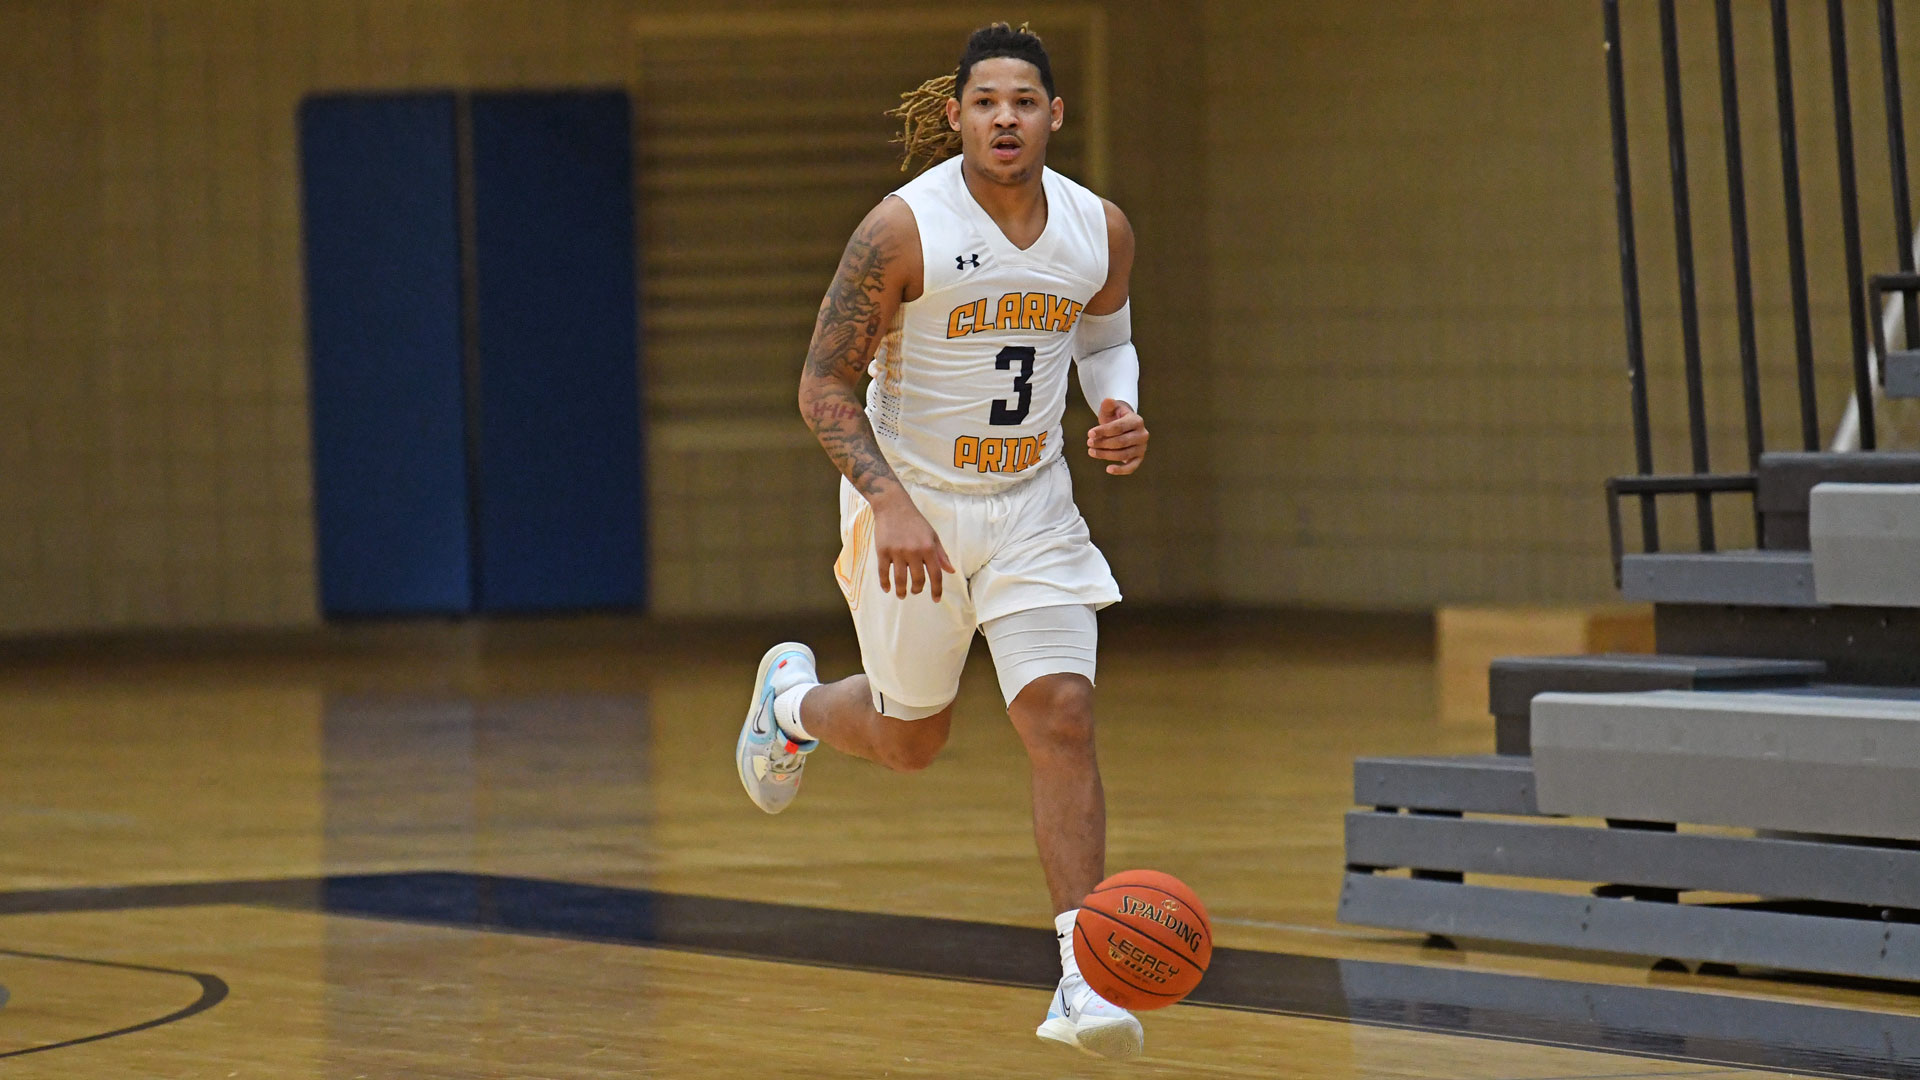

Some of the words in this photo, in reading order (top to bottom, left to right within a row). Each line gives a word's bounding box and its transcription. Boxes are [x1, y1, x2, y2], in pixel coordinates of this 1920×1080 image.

[947, 292, 1083, 339] CLARKE
[989, 346, 1036, 425] 3
[954, 431, 1047, 473] PRIDE
[1118, 895, 1202, 953] SPALDING
[1107, 931, 1180, 977] LEGACY
